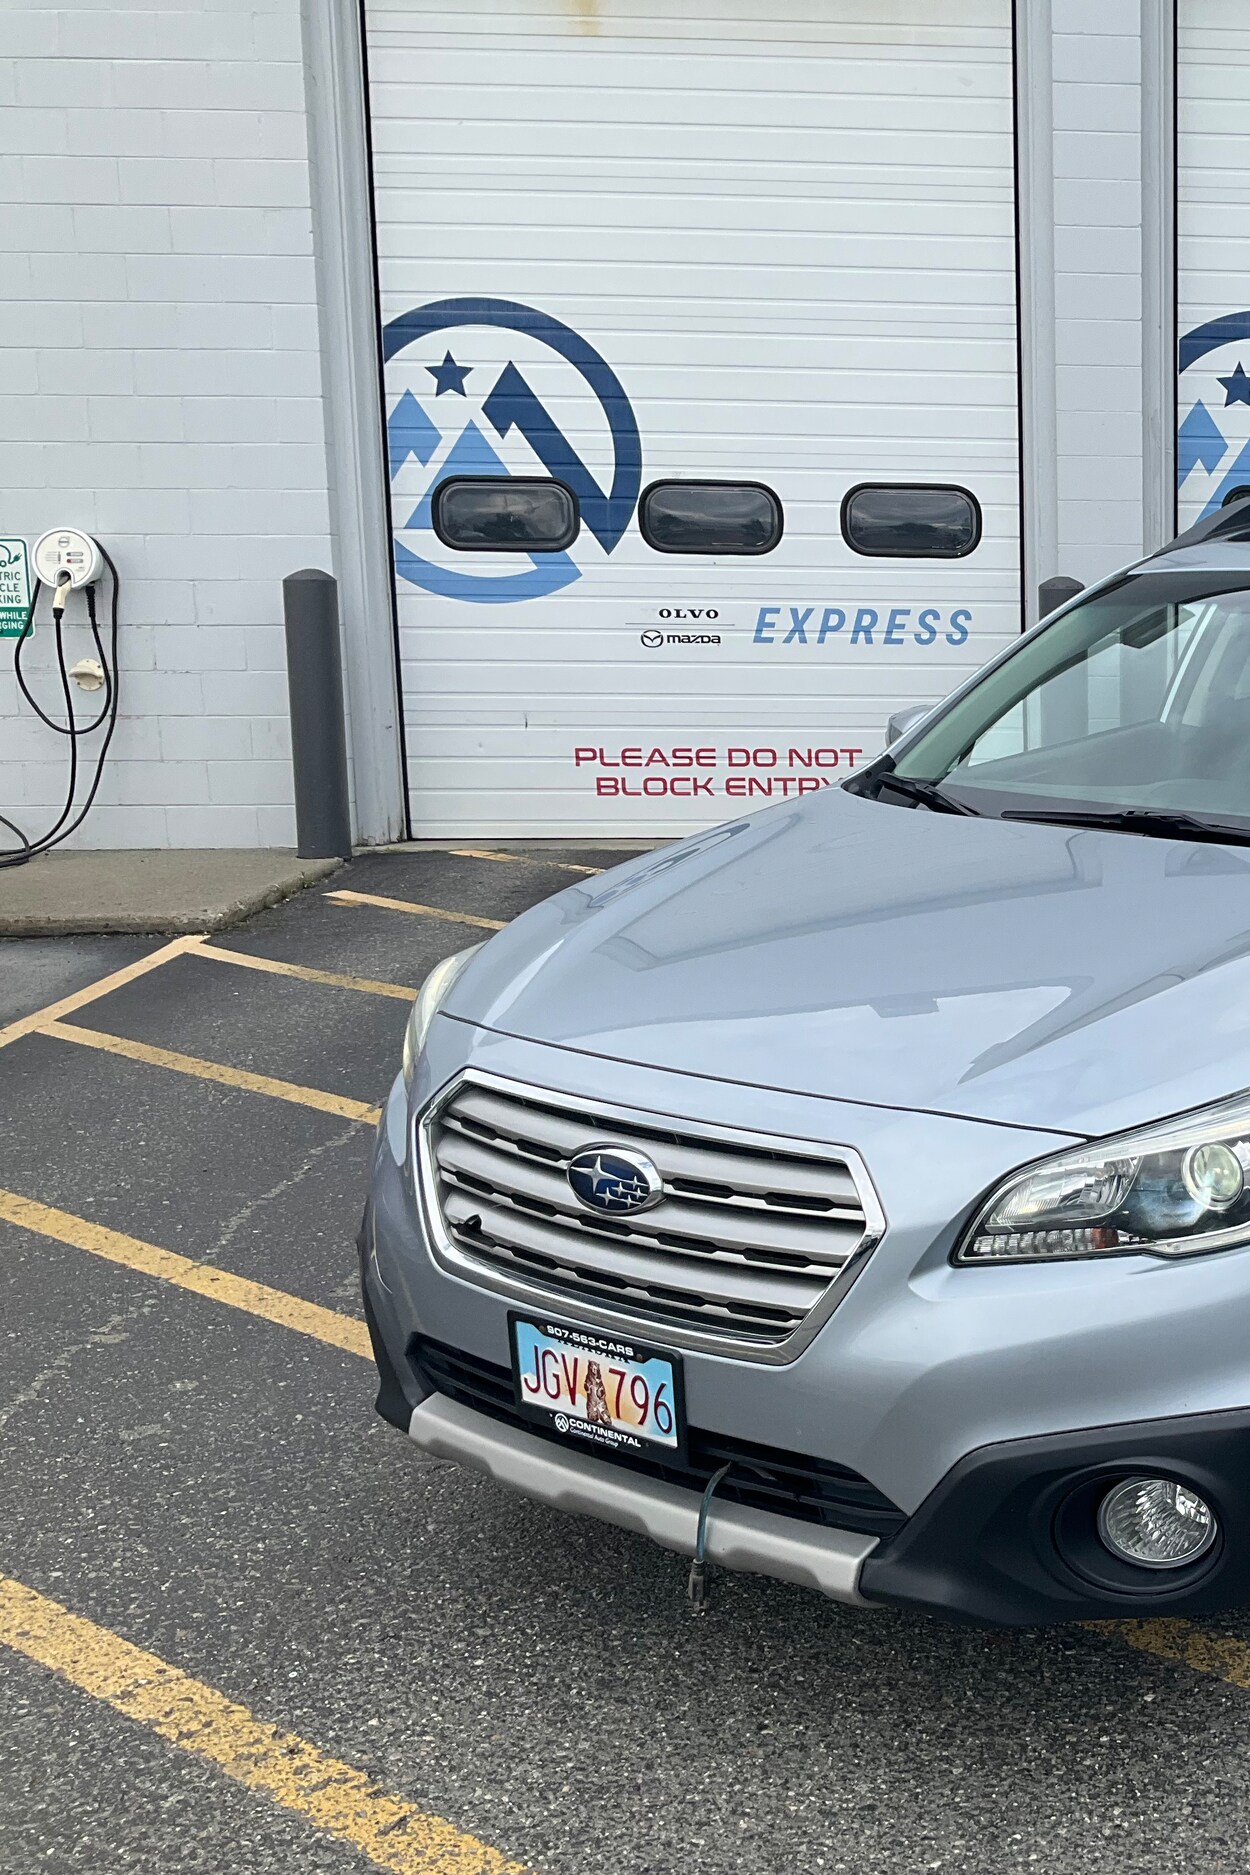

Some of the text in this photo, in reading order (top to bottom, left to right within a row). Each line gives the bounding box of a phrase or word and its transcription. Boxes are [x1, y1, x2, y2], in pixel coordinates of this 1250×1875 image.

[0, 621, 24, 630] GING
[659, 608, 719, 619] OLVO
[752, 607, 973, 645] EXPRESS
[575, 747, 863, 768] PLEASE DO NOT
[596, 777, 715, 797] BLOCK
[546, 1325, 635, 1357] 907-563-CARS
[523, 1343, 673, 1434] JGV 796
[569, 1418, 642, 1448] CONTINENTAL
